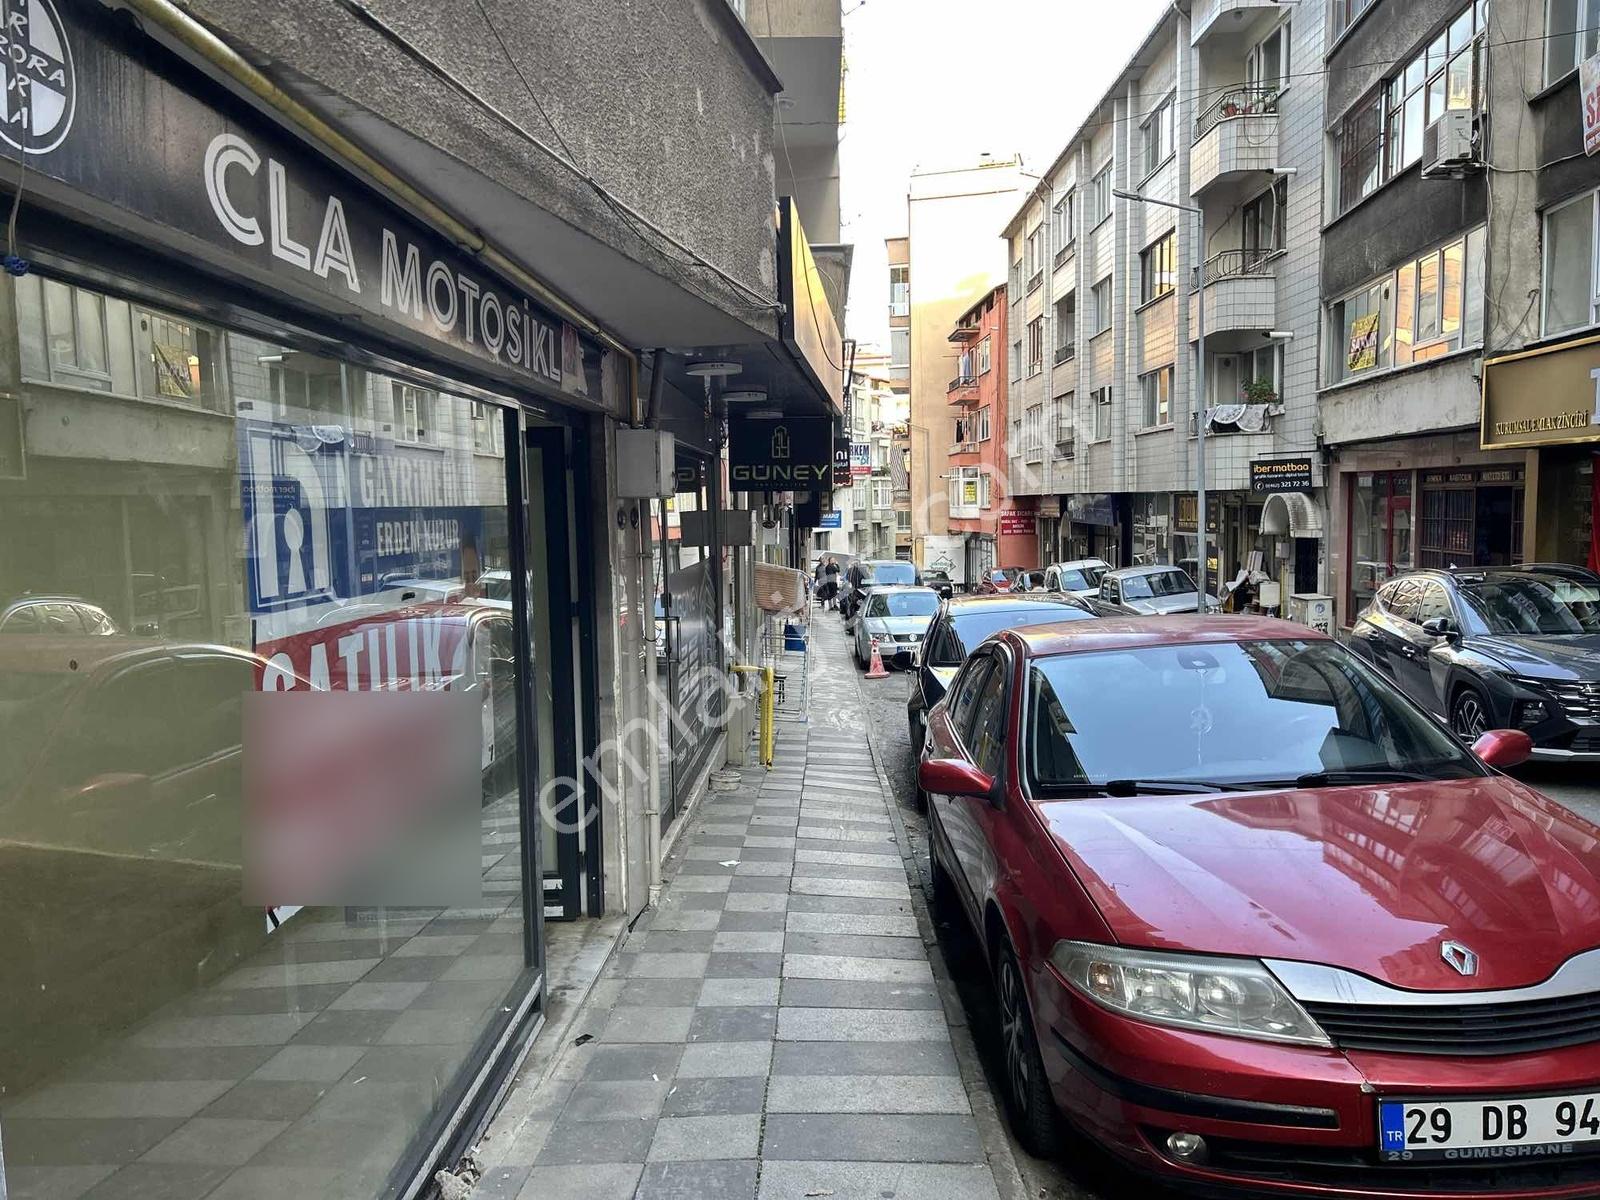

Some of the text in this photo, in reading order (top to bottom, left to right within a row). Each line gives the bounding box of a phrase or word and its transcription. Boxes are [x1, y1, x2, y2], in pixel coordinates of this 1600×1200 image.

[204, 133, 585, 386] CLA MOTOSİKL
[733, 464, 829, 481] GÜNEY
[377, 520, 420, 557] ERDEM
[1387, 1130, 1402, 1142] TR
[1405, 1108, 1452, 1144] 29
[1482, 1104, 1527, 1140] DB
[1388, 1151, 1413, 1161] 29
